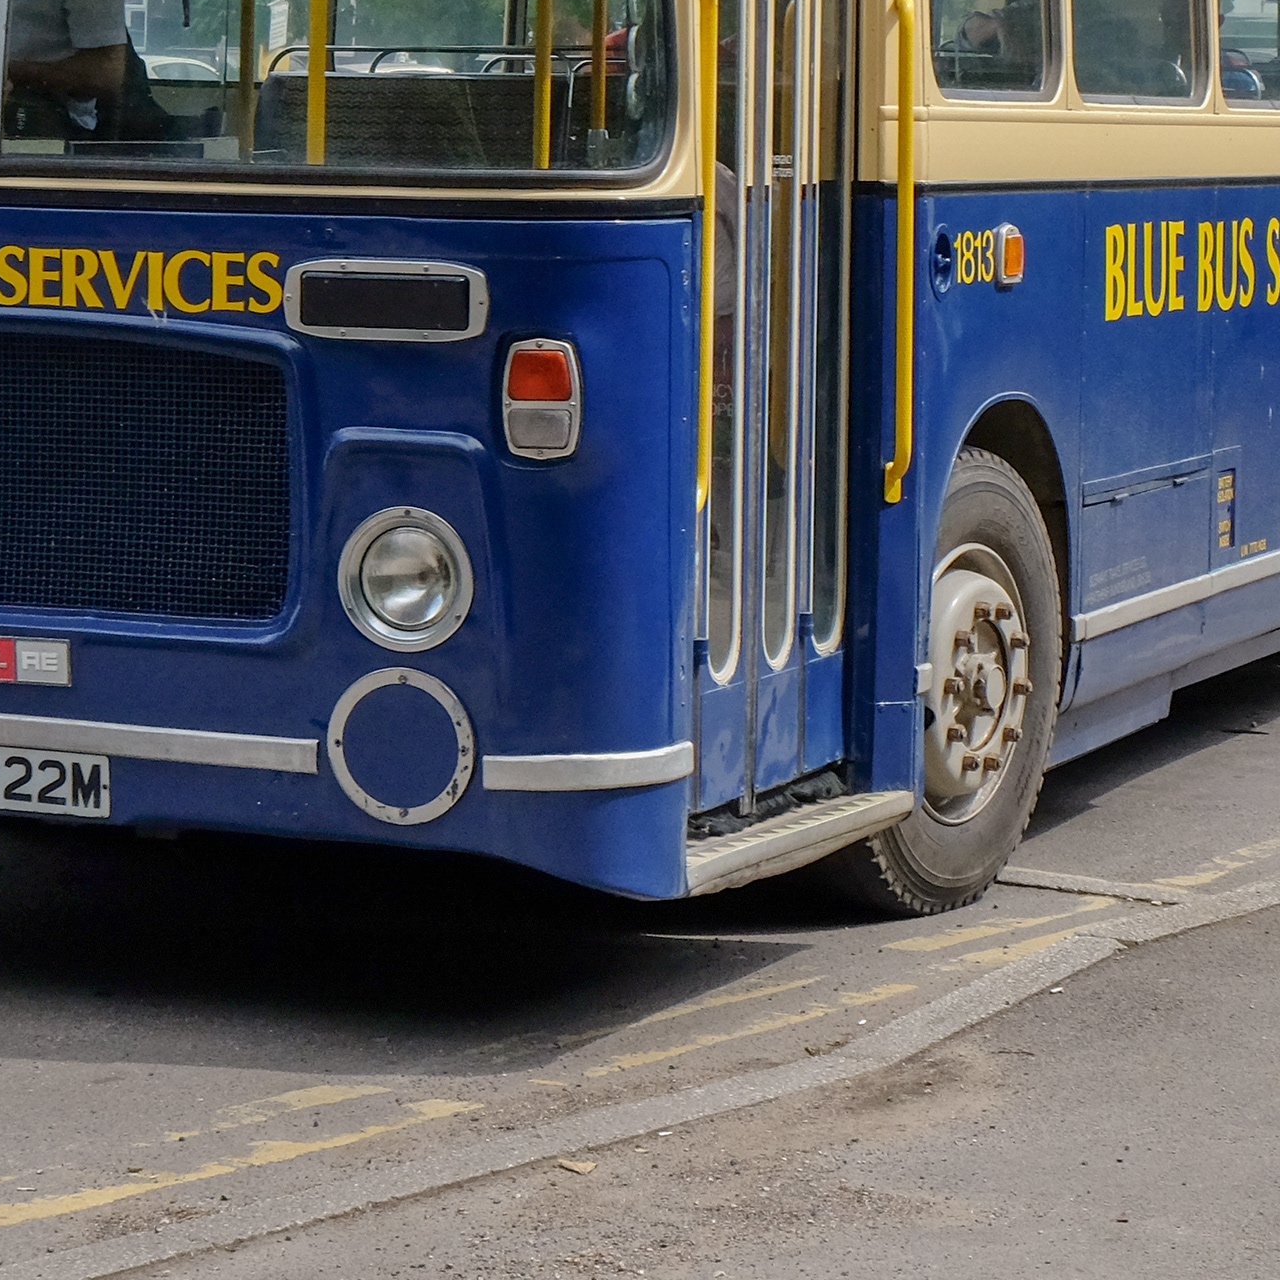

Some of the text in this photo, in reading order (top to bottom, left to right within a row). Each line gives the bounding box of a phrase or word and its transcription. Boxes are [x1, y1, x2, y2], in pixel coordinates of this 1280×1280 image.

[953, 229, 995, 285] 1813
[1104, 220, 1185, 322] BLUE
[1197, 217, 1256, 312] BUS
